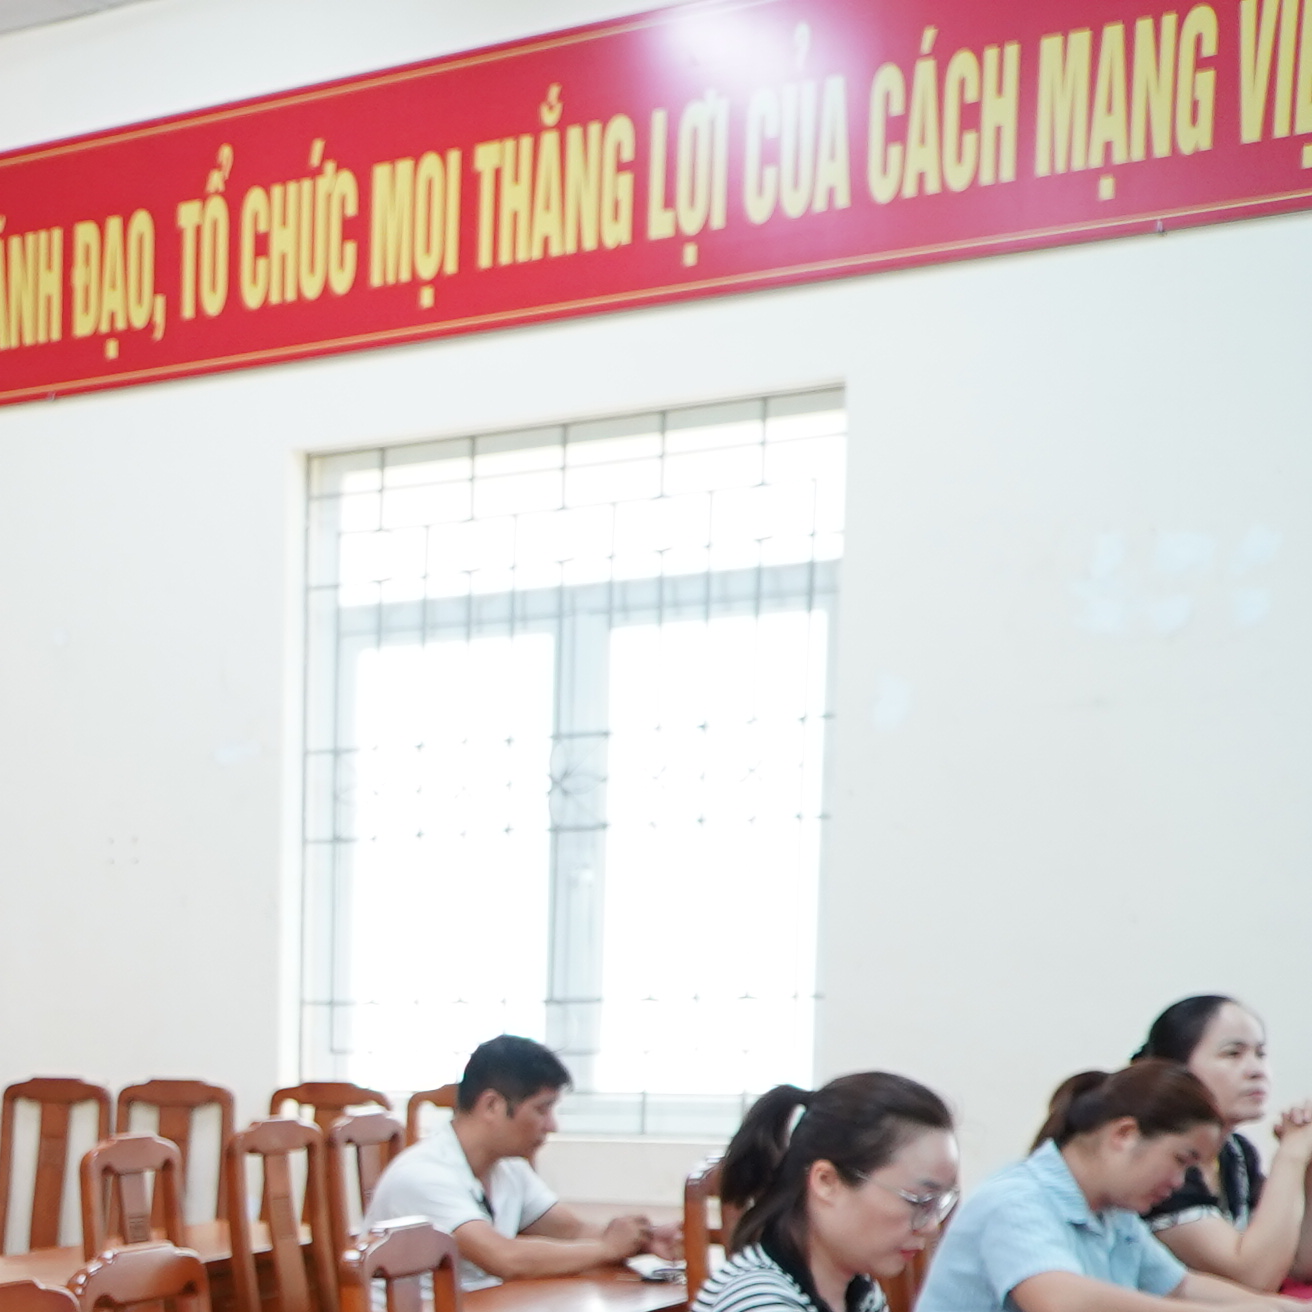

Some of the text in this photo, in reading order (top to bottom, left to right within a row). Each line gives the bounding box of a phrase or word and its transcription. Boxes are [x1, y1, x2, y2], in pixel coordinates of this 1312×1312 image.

[72, 209, 166, 359] ĐẠO,
[177, 144, 234, 321] TỔ
[240, 138, 359, 311] CHỨC
[370, 149, 462, 310] MỌI
[475, 82, 635, 270] THẮNG
[647, 87, 730, 268] LỢI
[744, 22, 852, 226] CỦA
[867, 26, 1022, 204] CÁCH
[1035, 2, 1220, 201] MẠNG
